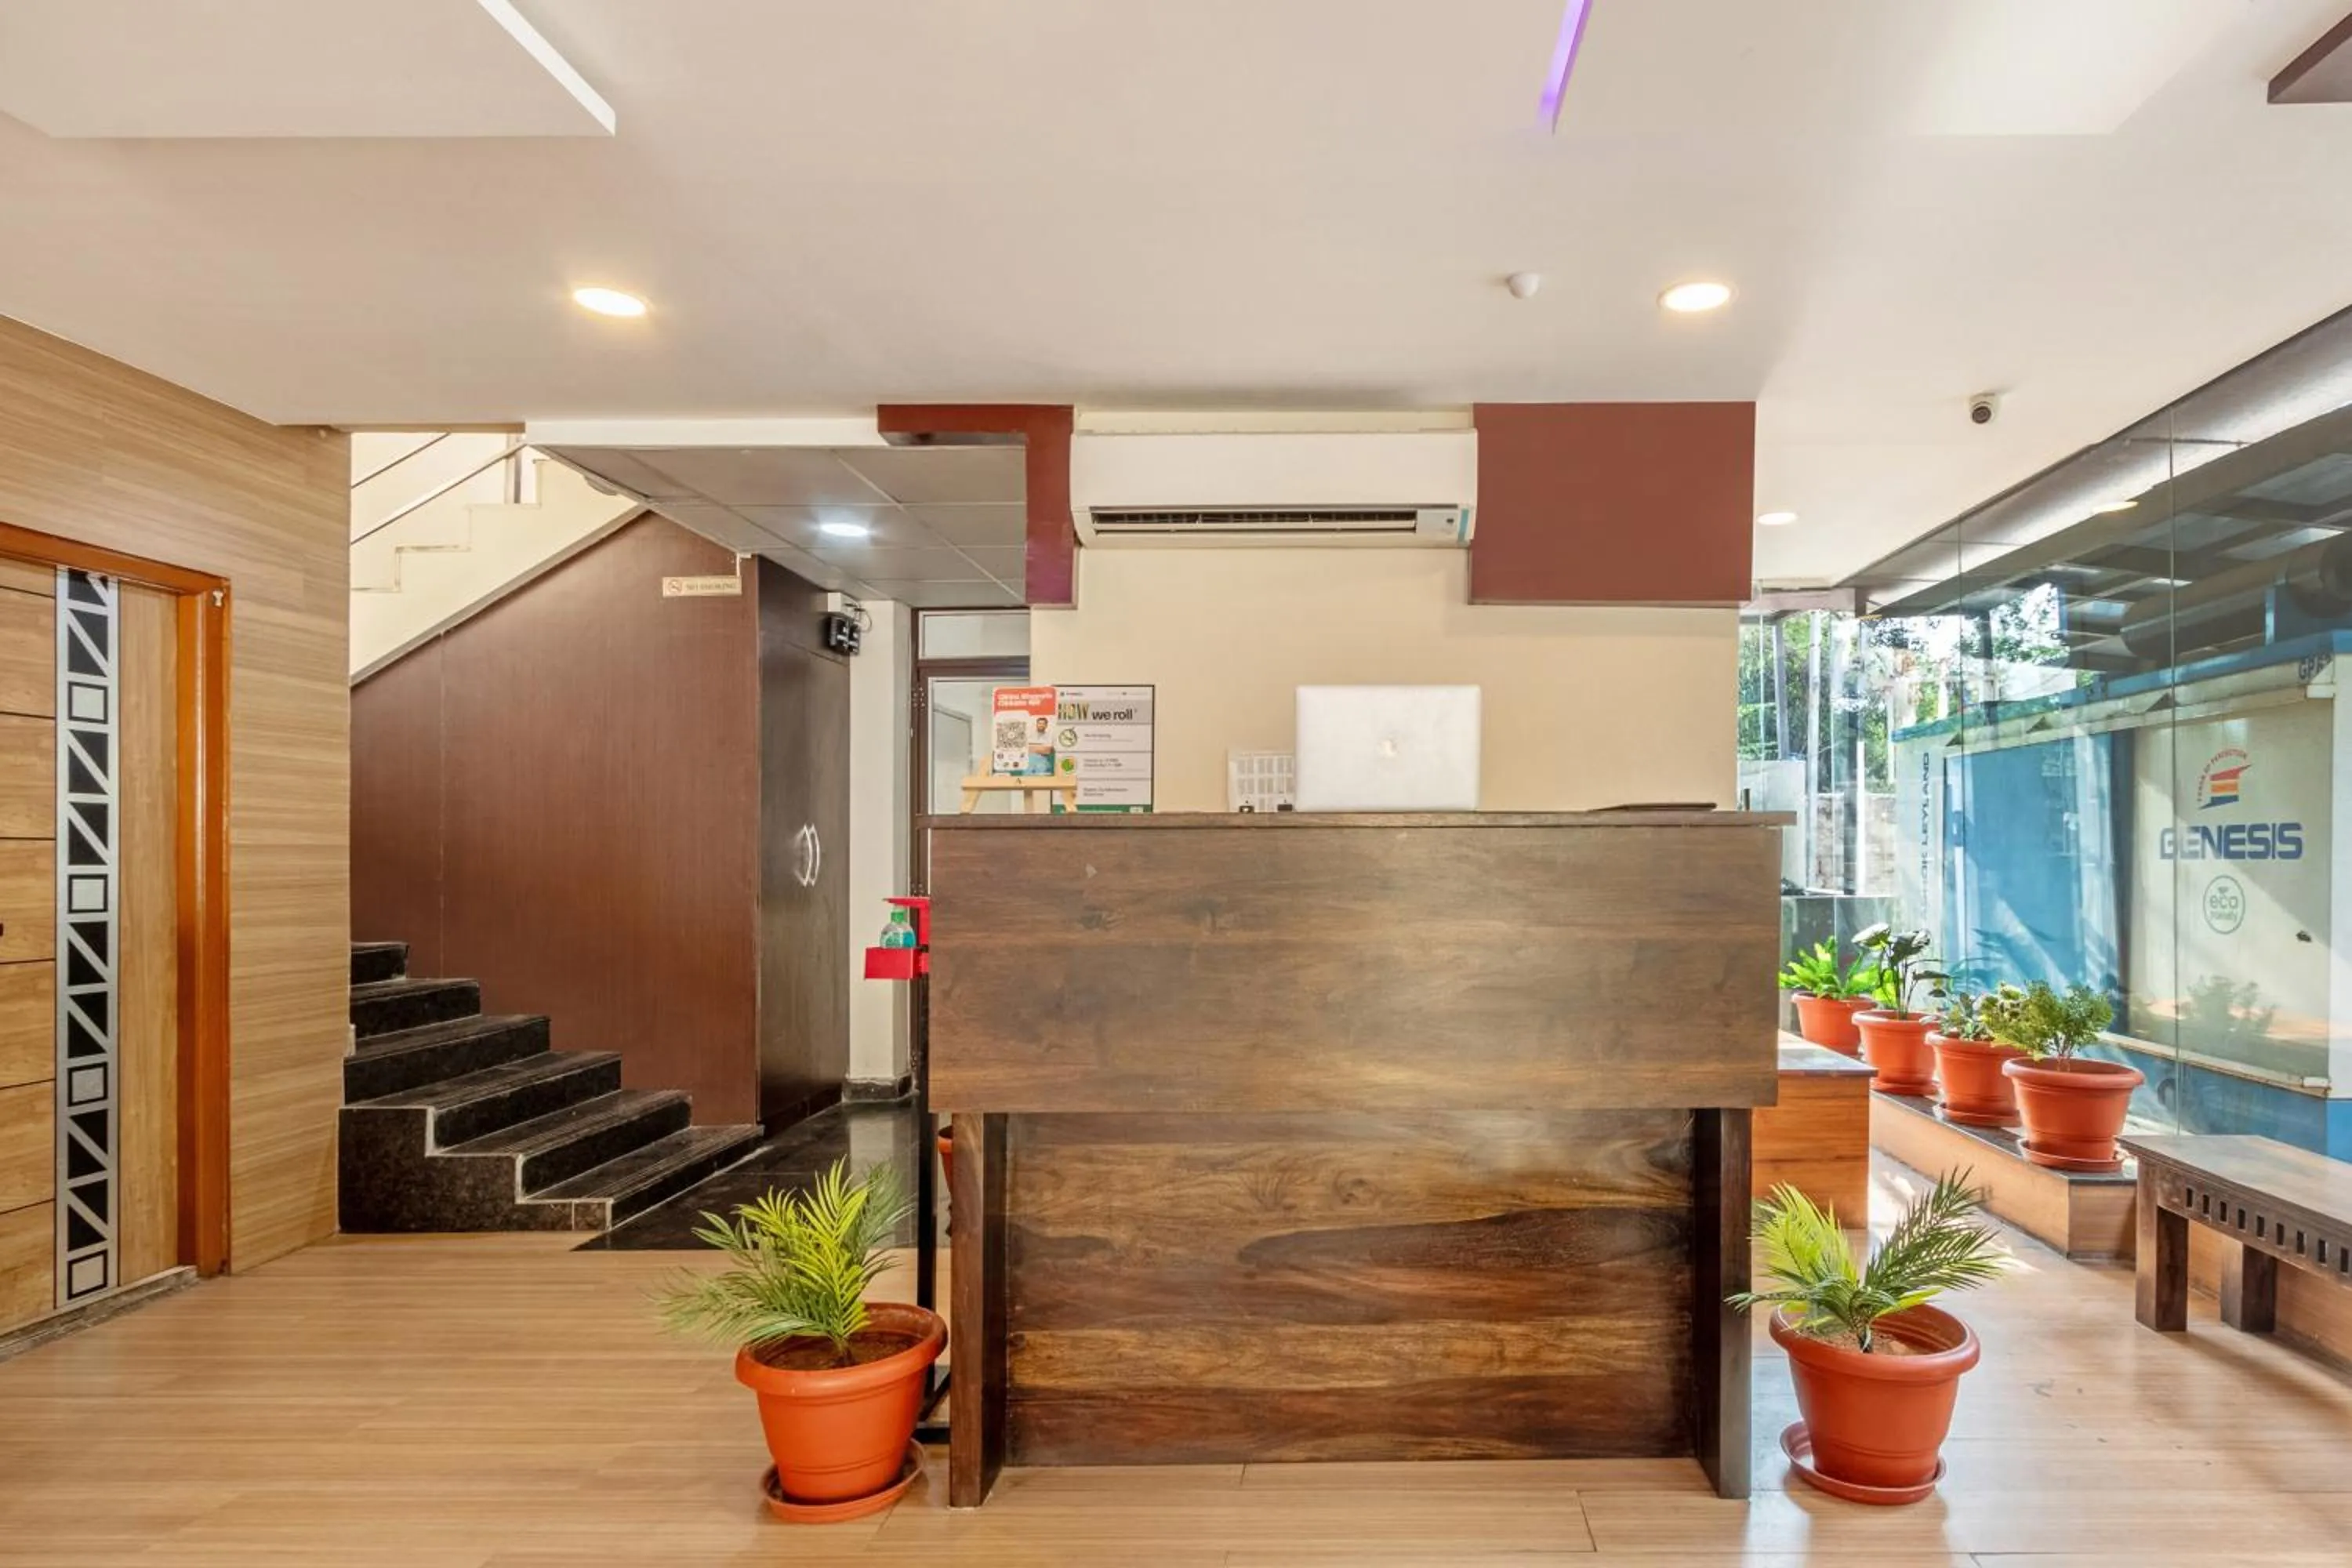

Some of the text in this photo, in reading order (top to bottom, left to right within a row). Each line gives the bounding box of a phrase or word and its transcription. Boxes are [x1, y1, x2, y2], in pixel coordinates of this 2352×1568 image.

[1091, 710, 1111, 720] we
[1113, 708, 1133, 720] roll
[1921, 752, 1929, 846] LEYLAND
[2160, 823, 2303, 860] GENESIS
[2209, 895, 2238, 909] eco
